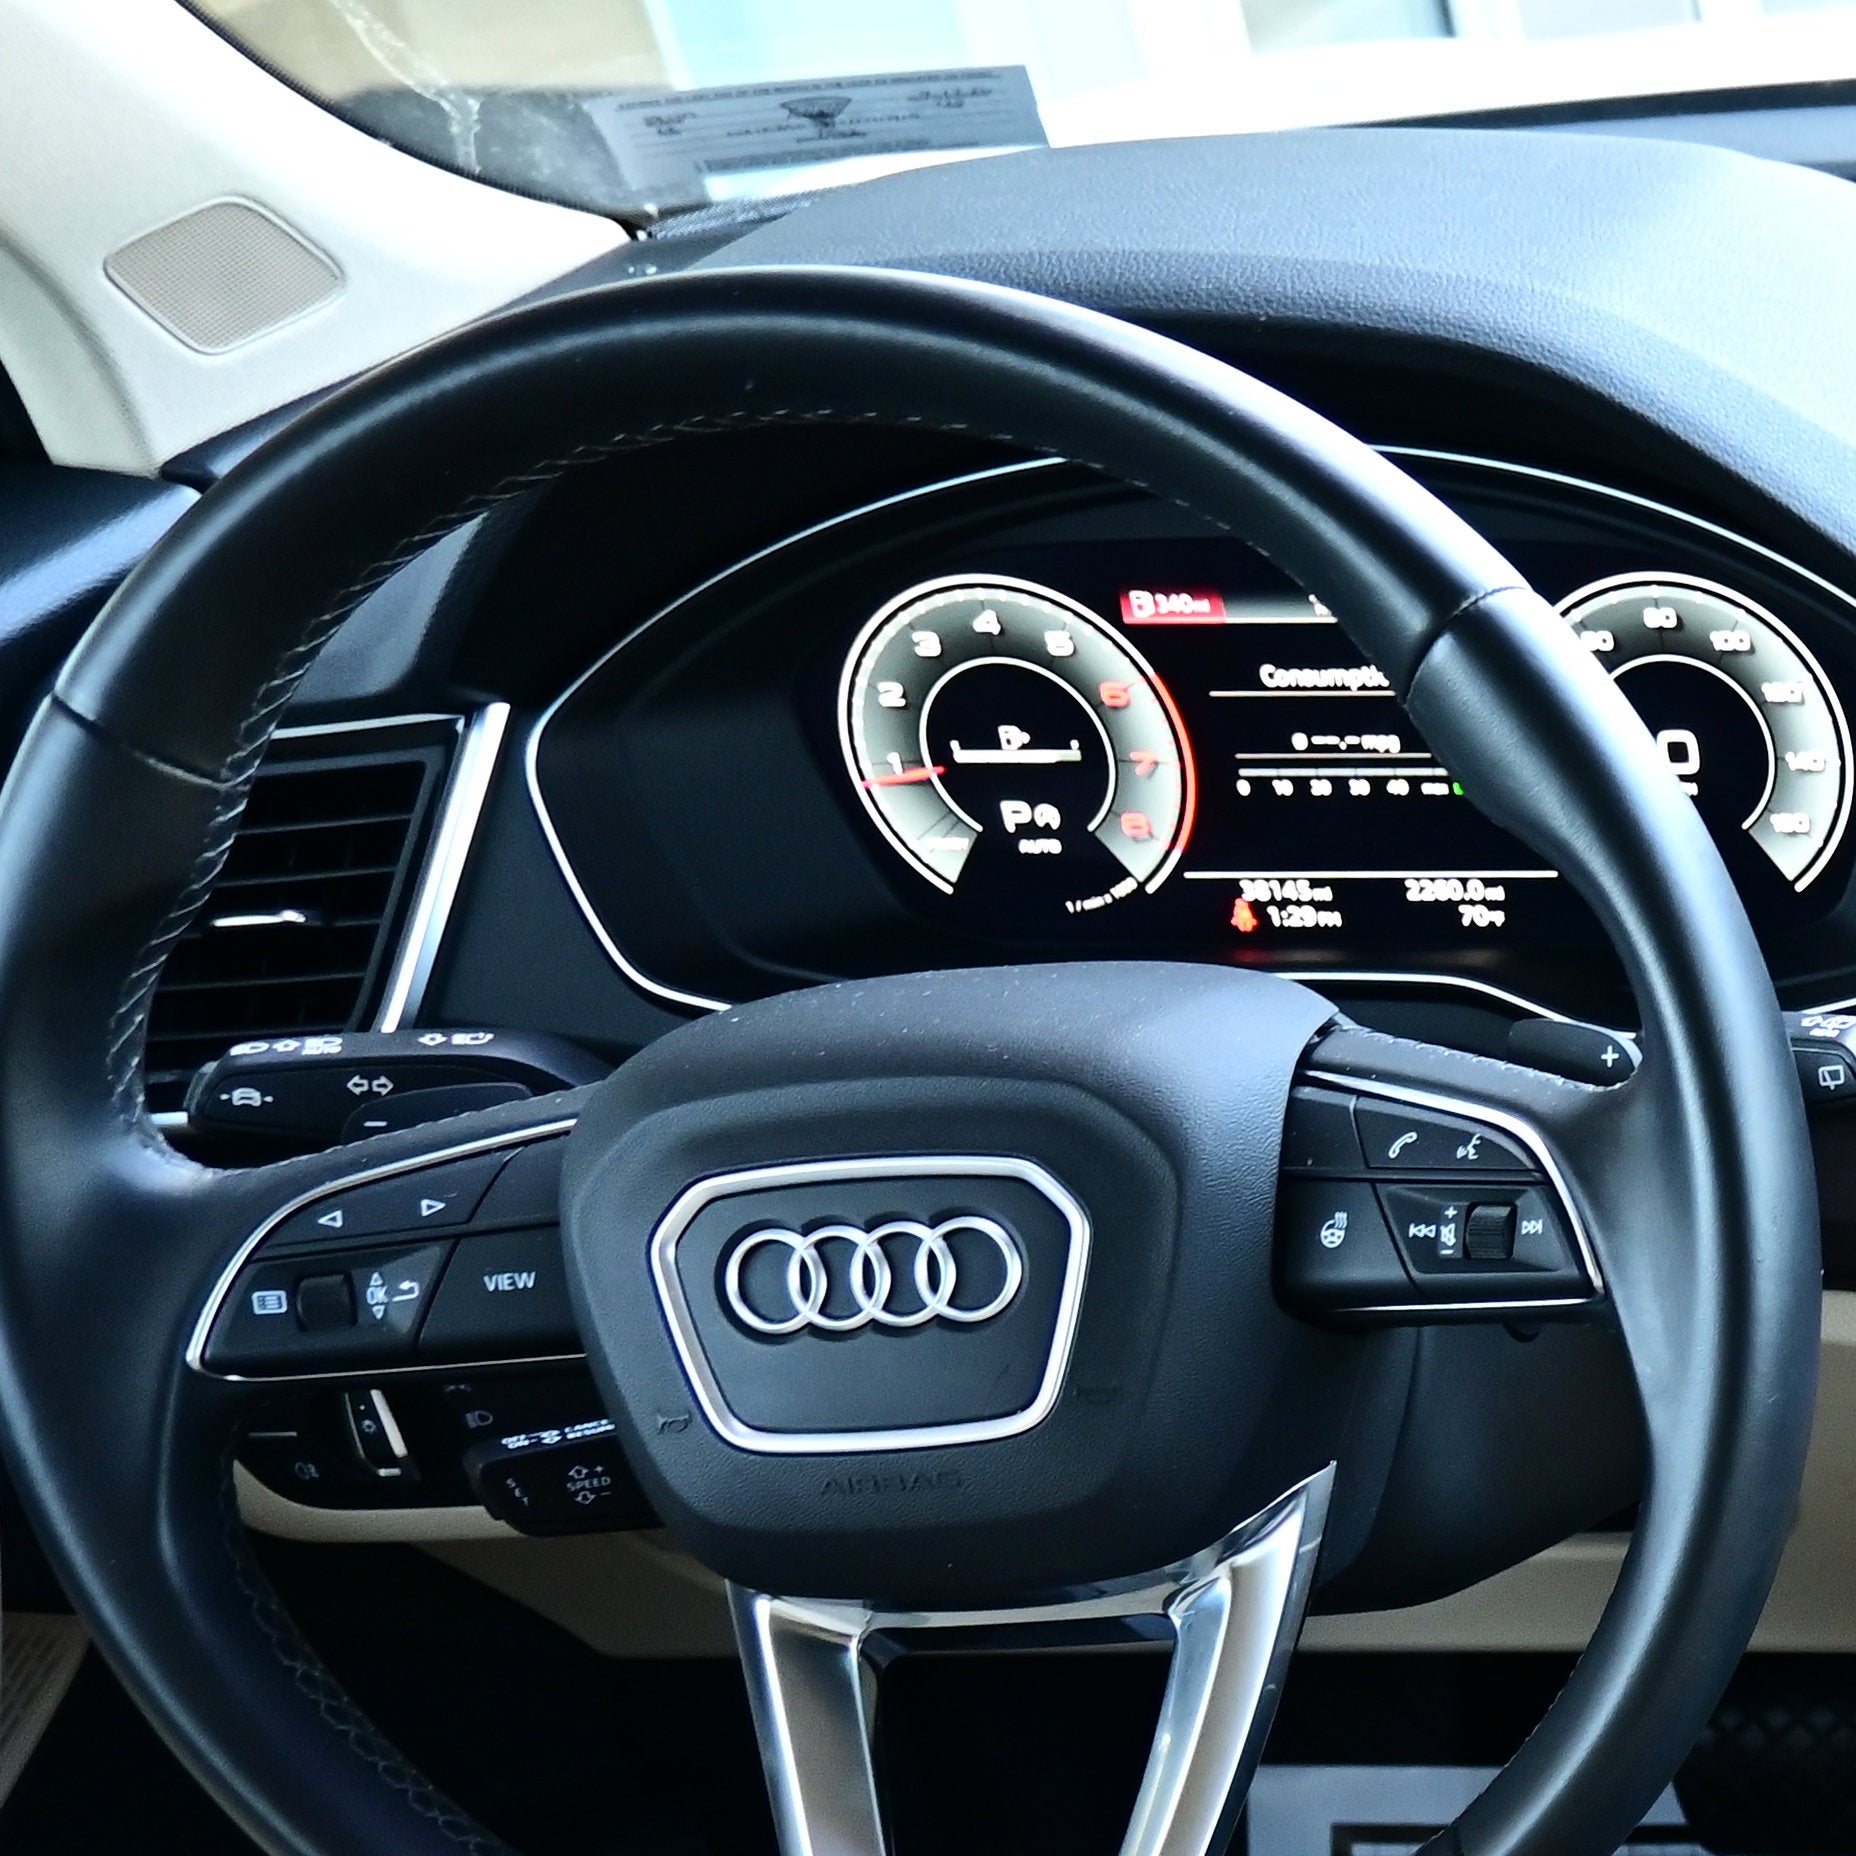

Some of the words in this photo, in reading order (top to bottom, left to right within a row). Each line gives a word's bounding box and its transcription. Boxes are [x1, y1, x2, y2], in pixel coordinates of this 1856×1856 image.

[972, 610, 1001, 635] 4
[911, 631, 941, 657] 3
[1044, 630, 1075, 657] 5
[1709, 630, 1751, 652] 100
[877, 681, 906, 708] 2
[1099, 681, 1130, 707] 6
[1129, 751, 1158, 776] 7
[483, 1271, 536, 1291] VIEW
[365, 1284, 390, 1305] OK
[566, 1476, 611, 1492] SPEED
